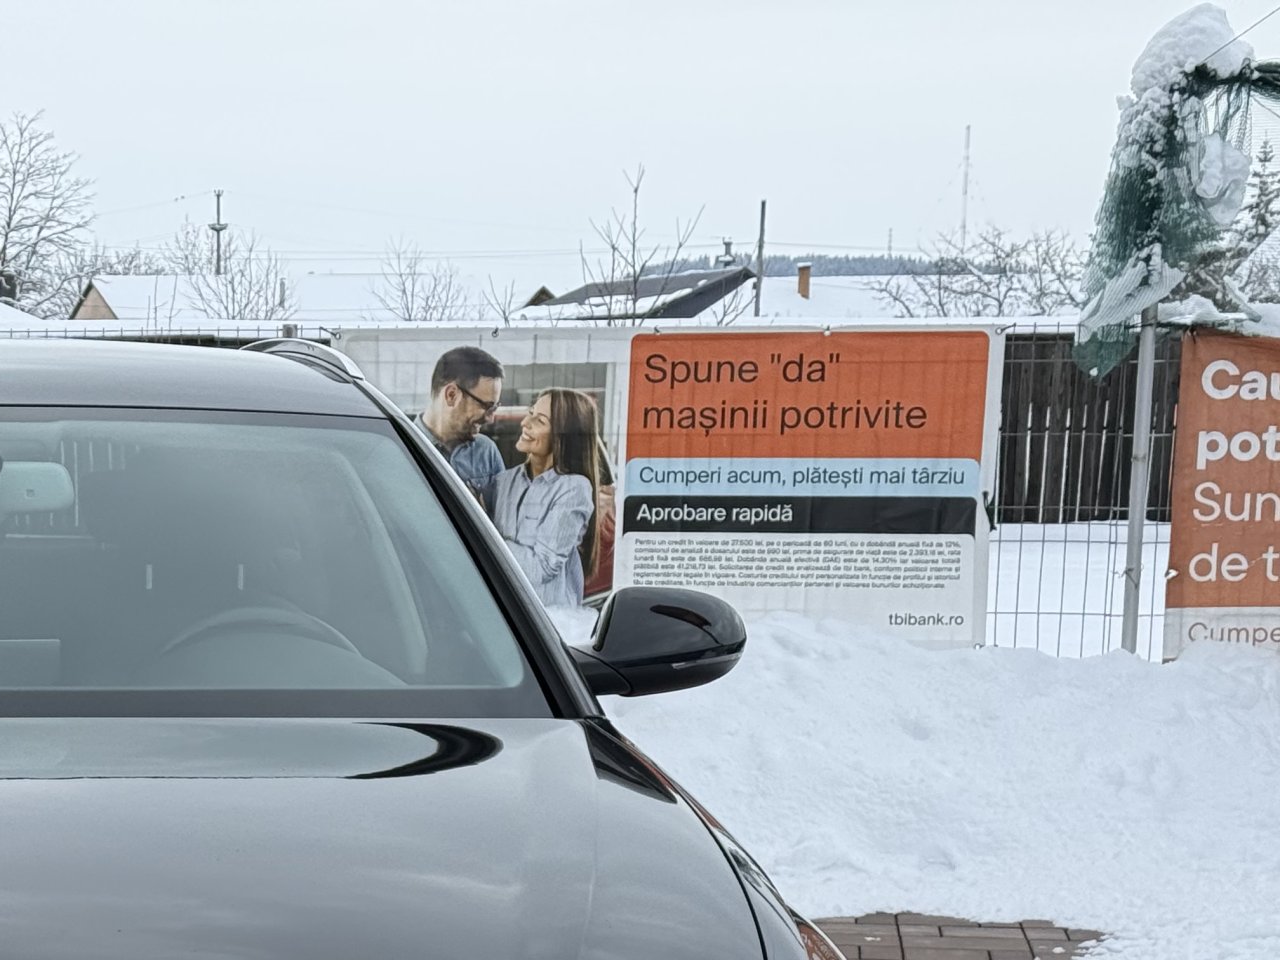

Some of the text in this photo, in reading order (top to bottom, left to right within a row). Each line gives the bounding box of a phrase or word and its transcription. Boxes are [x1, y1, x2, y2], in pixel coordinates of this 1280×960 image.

[644, 352, 841, 390] Spune "da"
[642, 400, 928, 437] mașinii potrivite
[639, 466, 722, 488] Cumperi
[727, 470, 787, 487] acum,
[869, 467, 905, 484] mai
[911, 466, 965, 485] târziu
[636, 503, 794, 526] Aprobare rapidă
[1193, 481, 1280, 522] Sun
[1189, 542, 1249, 582] de
[888, 612, 964, 626] tbibank.ro
